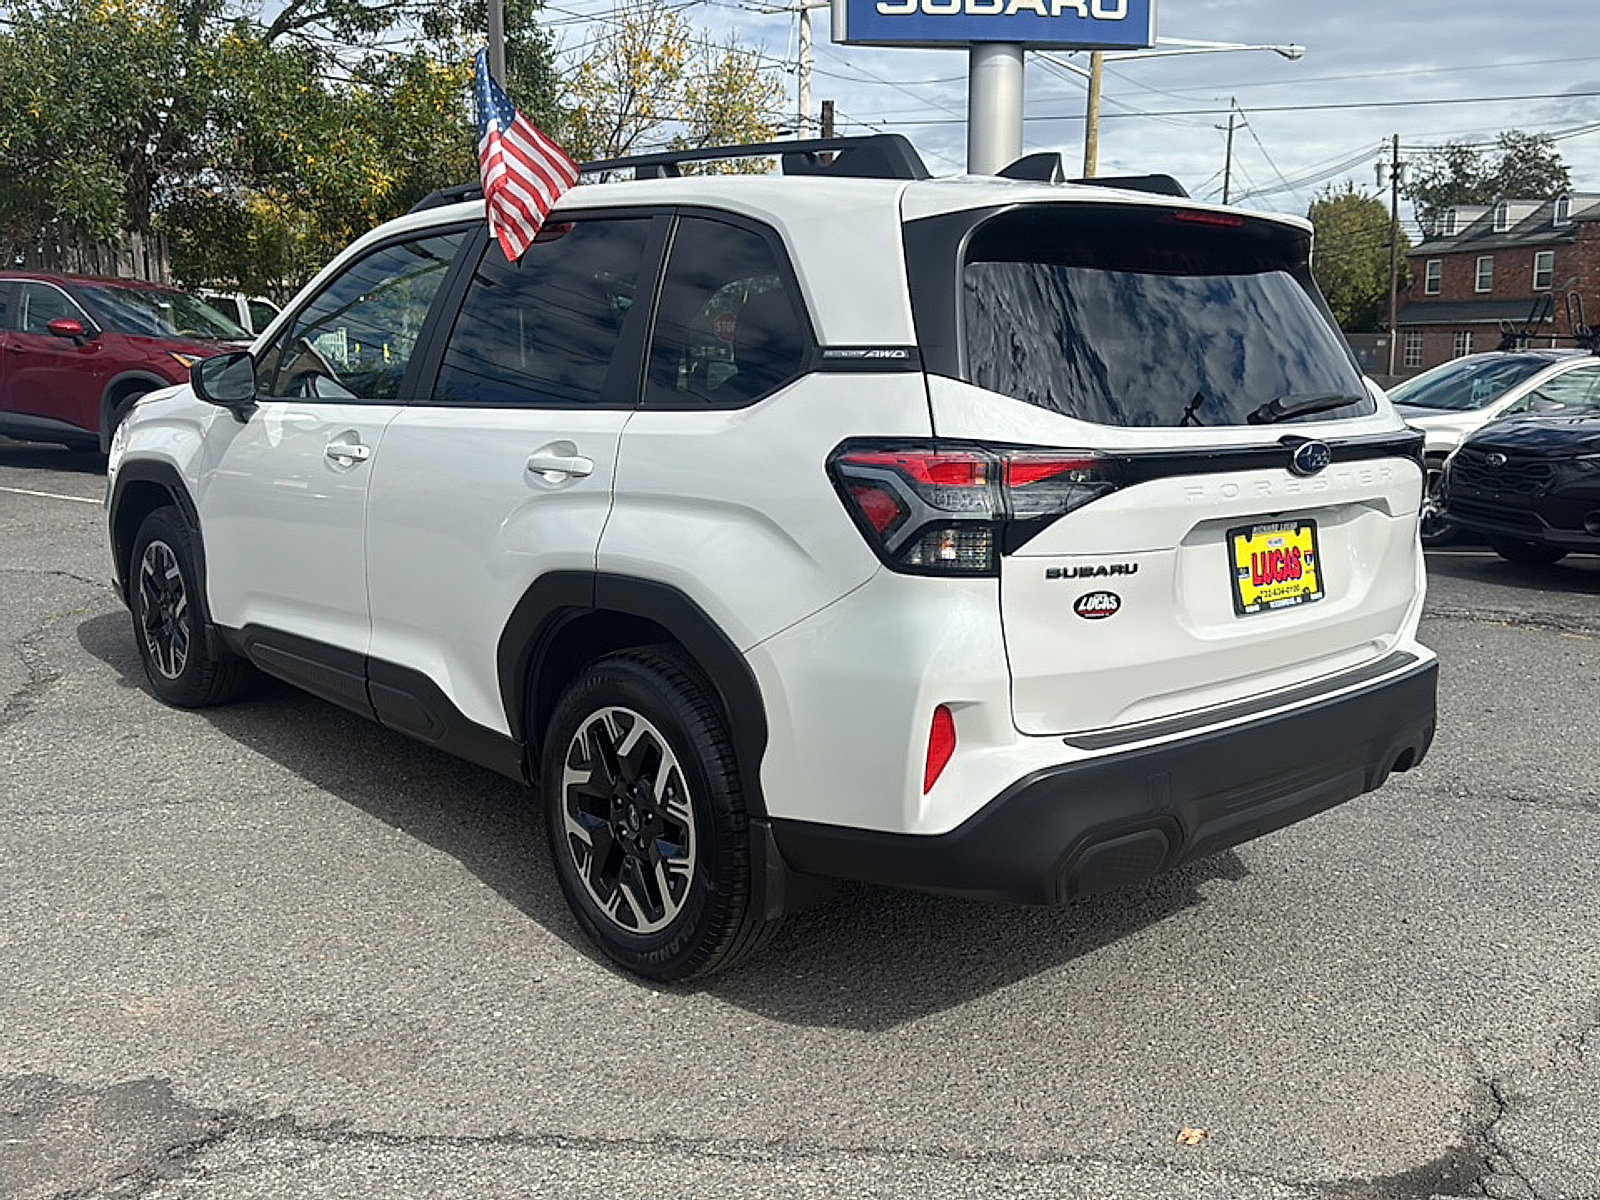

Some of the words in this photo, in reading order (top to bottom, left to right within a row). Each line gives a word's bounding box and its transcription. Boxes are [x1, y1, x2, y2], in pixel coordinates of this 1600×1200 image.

[1183, 466, 1393, 503] FORESTER
[1045, 563, 1138, 579] SUBARU
[1251, 546, 1302, 587] LUCAS
[1077, 595, 1118, 611] LUCAS
